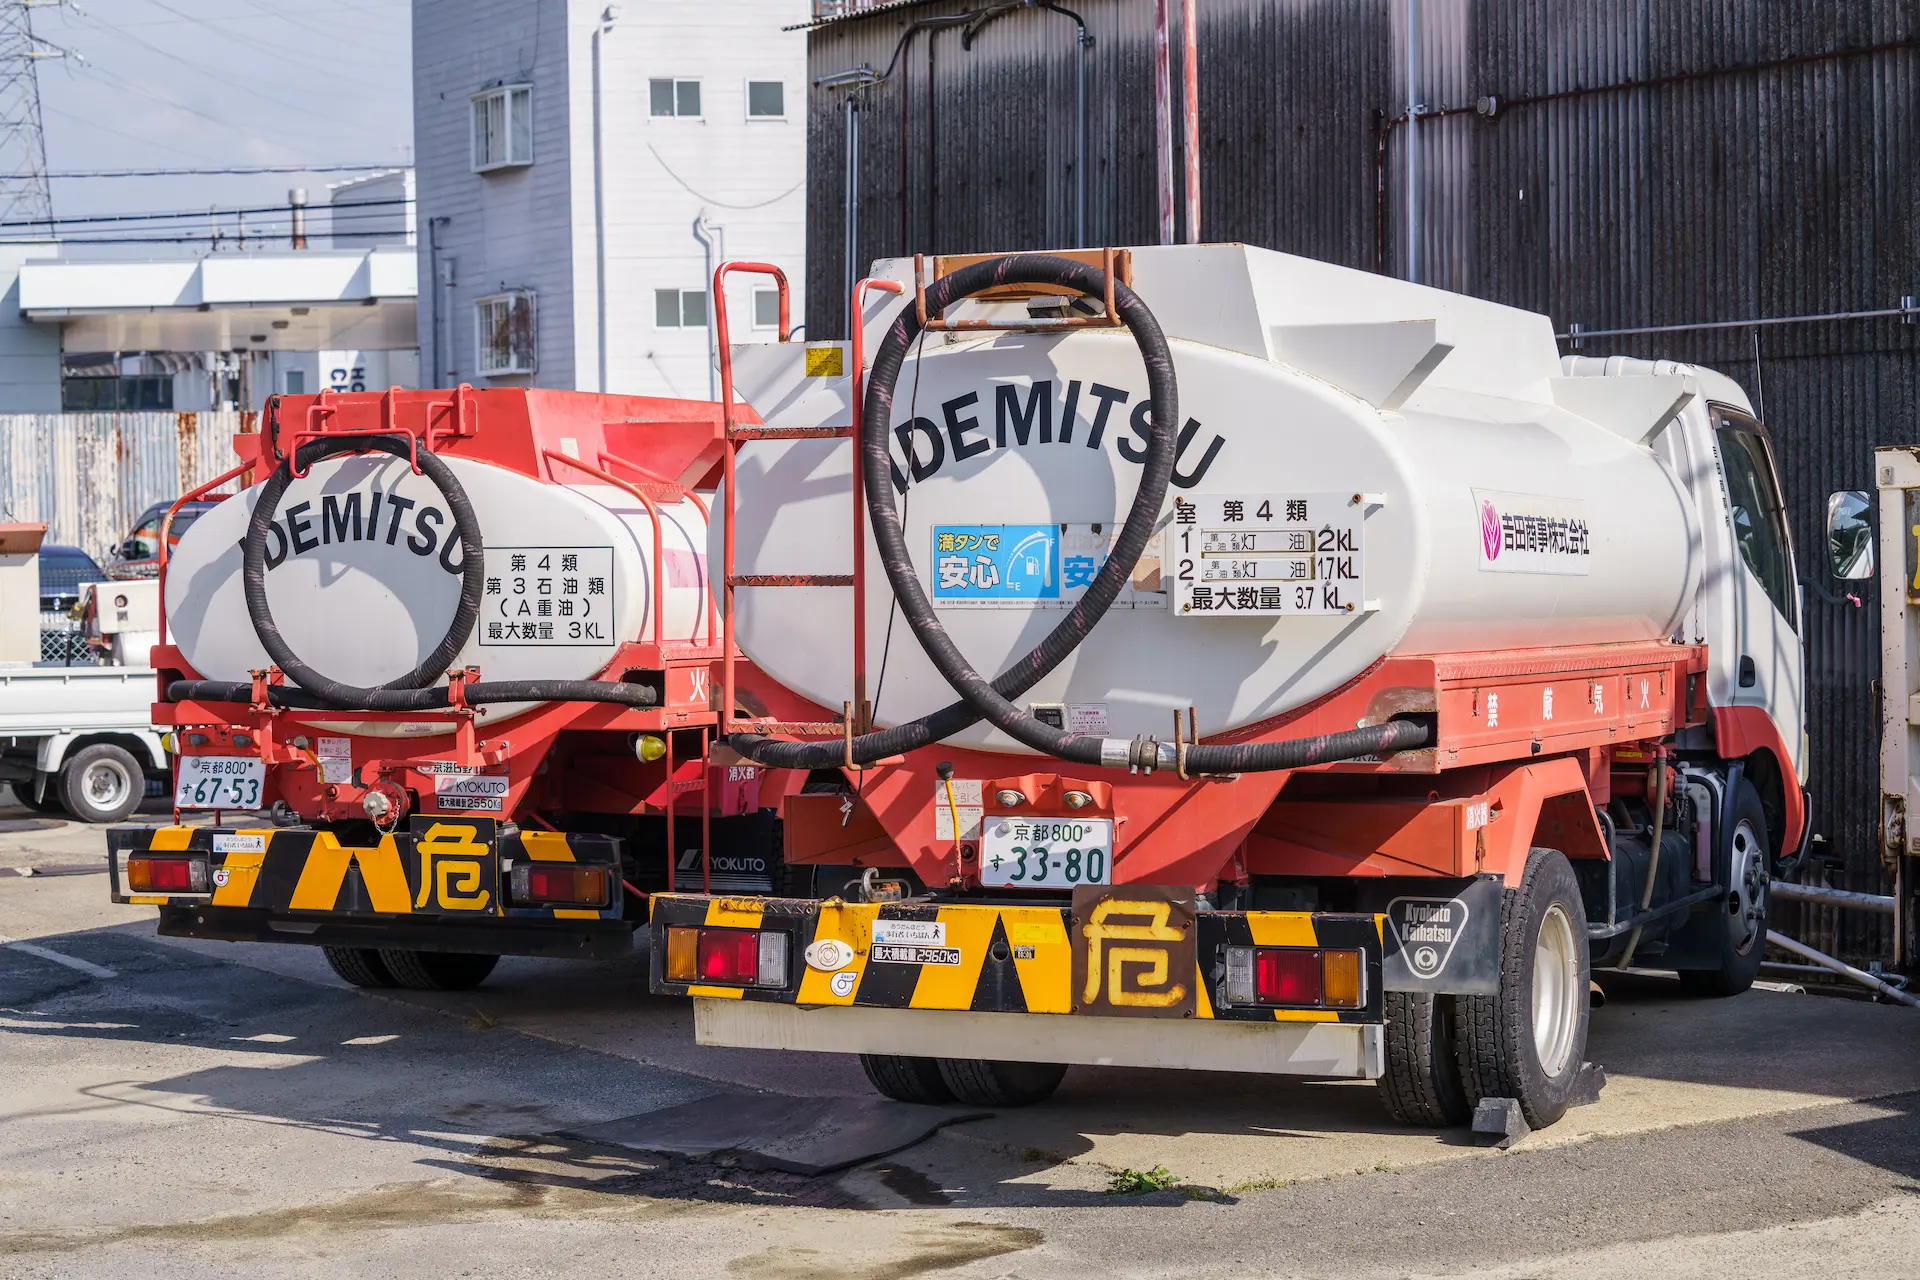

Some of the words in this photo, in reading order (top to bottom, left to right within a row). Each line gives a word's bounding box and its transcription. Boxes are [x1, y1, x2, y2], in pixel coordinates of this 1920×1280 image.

[938, 533, 1000, 552] 満タンで
[1501, 513, 1590, 555] 吉田商事株式会社
[938, 554, 1001, 589] 安心
[1063, 555, 1108, 589] 安
[1191, 587, 1282, 610] 最大数量
[488, 621, 554, 639] 最大数量
[690, 667, 706, 701] 火
[729, 766, 755, 782] 消火器
[195, 777, 259, 804] 67-53
[456, 781, 506, 793] KYOKUTO
[417, 822, 490, 910] 危
[703, 857, 766, 872] YOKUTO
[1010, 846, 1104, 883] 33-80
[1405, 903, 1451, 926] Kyokuto
[1402, 923, 1452, 943] Kaihatsu
[1082, 895, 1186, 1007] 危
